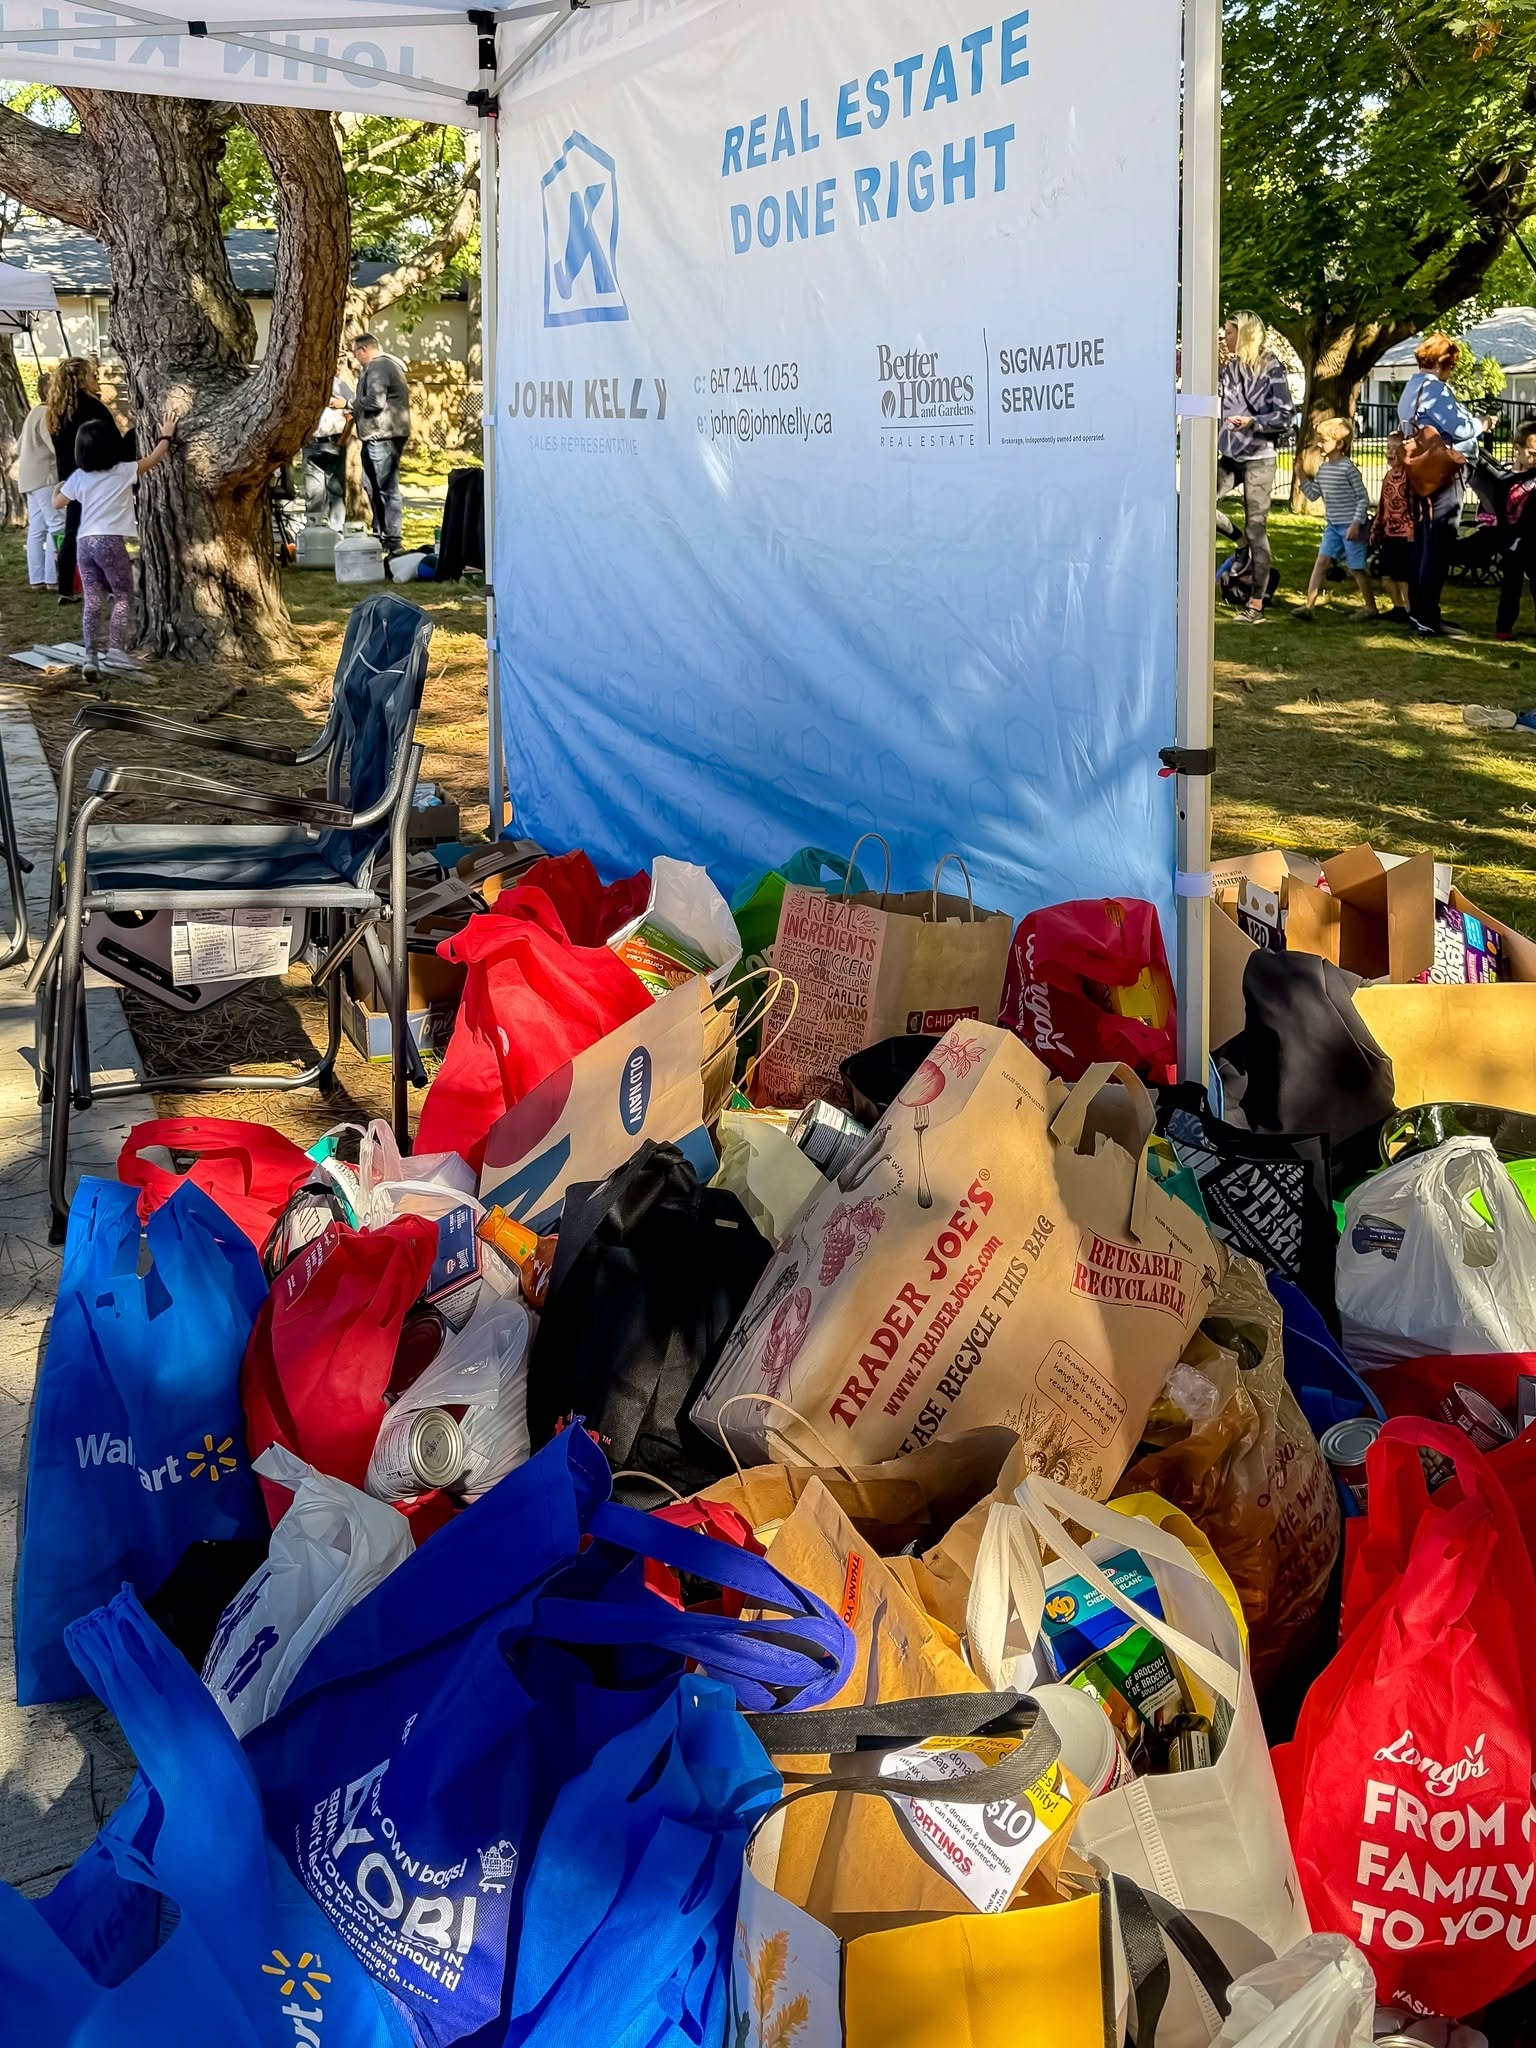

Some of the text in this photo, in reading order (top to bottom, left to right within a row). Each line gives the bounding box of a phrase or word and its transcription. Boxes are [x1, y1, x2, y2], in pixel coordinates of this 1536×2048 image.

[722, 9, 1030, 176] REAL ESTATE
[730, 123, 1016, 254] DONE RIGHT
[876, 344, 938, 381] Better
[1000, 338, 1104, 375] SIGNATURE
[508, 378, 667, 420] JOHN KELLY
[710, 362, 800, 394] 647.244.1053
[897, 375, 974, 418] Homes
[1001, 383, 1075, 413] SERVICE
[711, 408, 832, 442] john@johnkelly.ca
[921, 403, 974, 417] and Gardens
[529, 436, 559, 451] SALES
[880, 435, 974, 447] REAL ESTATE
[1073, 434, 1081, 442] and
[808, 897, 857, 932] REAL
[783, 913, 876, 961] INGREDIENTS
[783, 937, 811, 951] TOMATO
[810, 948, 872, 979] CHICKEN
[821, 1001, 868, 1022] AVOCADO
[828, 984, 868, 1007] GARLIC
[814, 1042, 833, 1053] RICE
[628, 1055, 644, 1124] OLD NAVY
[923, 1178, 994, 1281] JOE'S
[1088, 1236, 1182, 1283] REUSABLE
[1073, 1262, 1186, 1318] RECYCLABLE
[829, 1282, 931, 1429] TRADER
[895, 1214, 1056, 1460] EASE RECYCLE THIS BAG
[1049, 1378, 1072, 1402] reusing
[1053, 1361, 1079, 1390] hanging
[1086, 1393, 1093, 1403] on
[1094, 1399, 1105, 1413] the
[1090, 1377, 1101, 1392] the
[1101, 1388, 1113, 1405] bag
[1112, 1403, 1125, 1415] and
[75, 1432, 182, 1492] Walart
[843, 1555, 860, 1624] THANK YO
[1083, 1590, 1099, 1600] WHI
[1119, 1575, 1143, 1590] BLANC
[1046, 1596, 1076, 1617] KD
[1125, 1656, 1166, 1688] OF BROCCOLI
[1132, 1666, 1169, 1696] DE BROCOLI
[1374, 1730, 1489, 1796] Longo's
[909, 1798, 975, 1874] FORTINOS
[985, 1799, 1032, 1840] $10
[1363, 1779, 1505, 1851] FROM
[381, 1818, 420, 1877] OWN
[419, 1858, 468, 1889] bags!
[934, 1806, 945, 1819] can
[946, 1817, 961, 1836] make
[965, 1837, 997, 1872] difference!
[949, 1805, 973, 1833] donation
[979, 1838, 1012, 1876] partnership.
[1356, 1840, 1535, 1905] FAMILY
[308, 1798, 460, 1992] Don't leave home without it!
[320, 1847, 354, 1903] YOUR
[356, 1900, 396, 1938] OWN
[443, 1951, 464, 1971] IN.
[347, 1921, 369, 1943] Jane
[1352, 1900, 1425, 1950] TO
[338, 1924, 387, 1971] Mississauga
[388, 1968, 400, 1983] On
